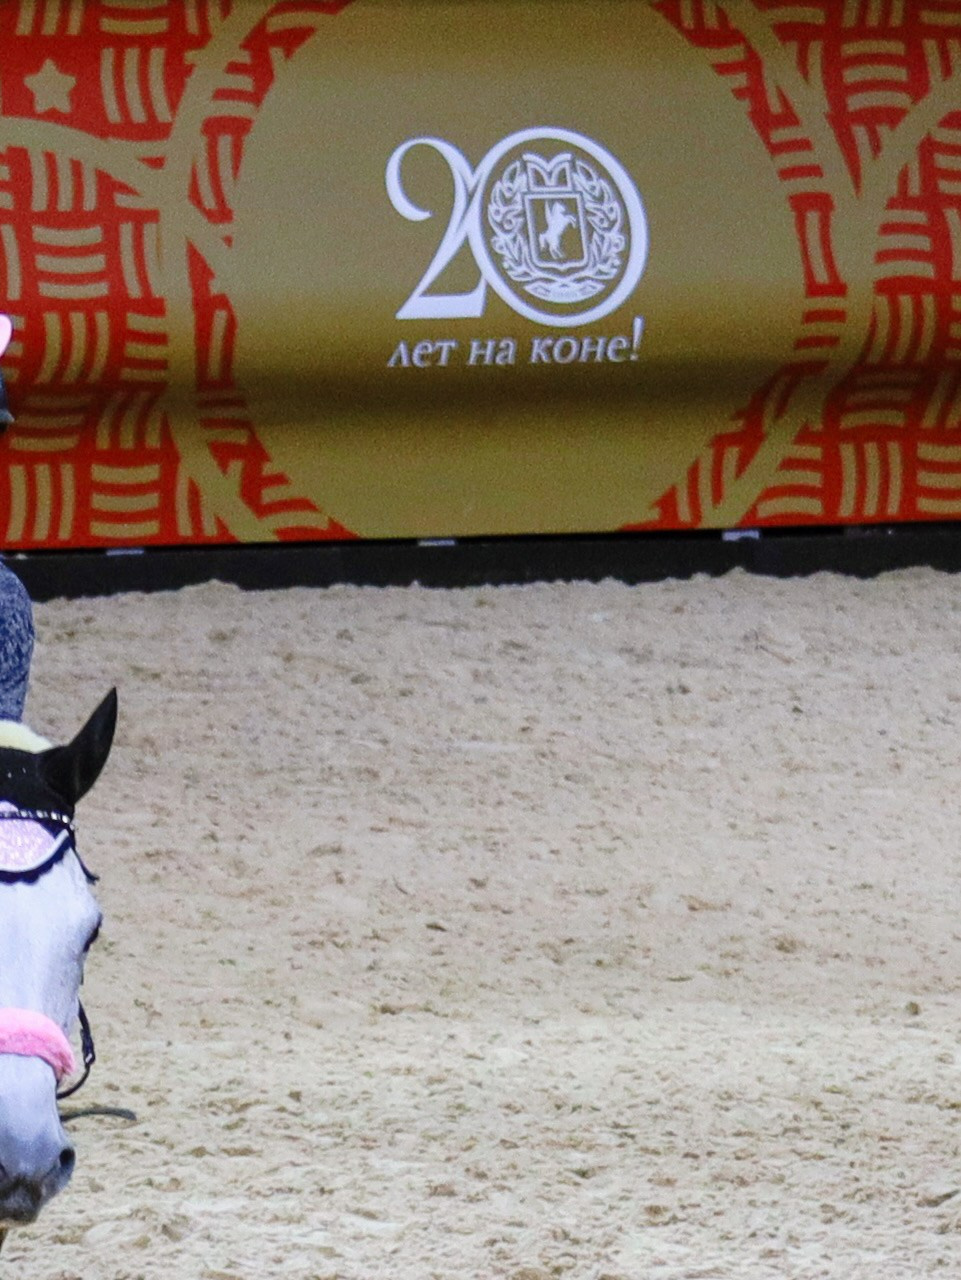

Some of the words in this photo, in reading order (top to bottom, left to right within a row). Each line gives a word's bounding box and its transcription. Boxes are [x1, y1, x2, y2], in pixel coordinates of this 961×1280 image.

[385, 125, 649, 327] 20
[387, 339, 458, 368] лет
[467, 338, 516, 366] на
[530, 316, 645, 364] коне!
